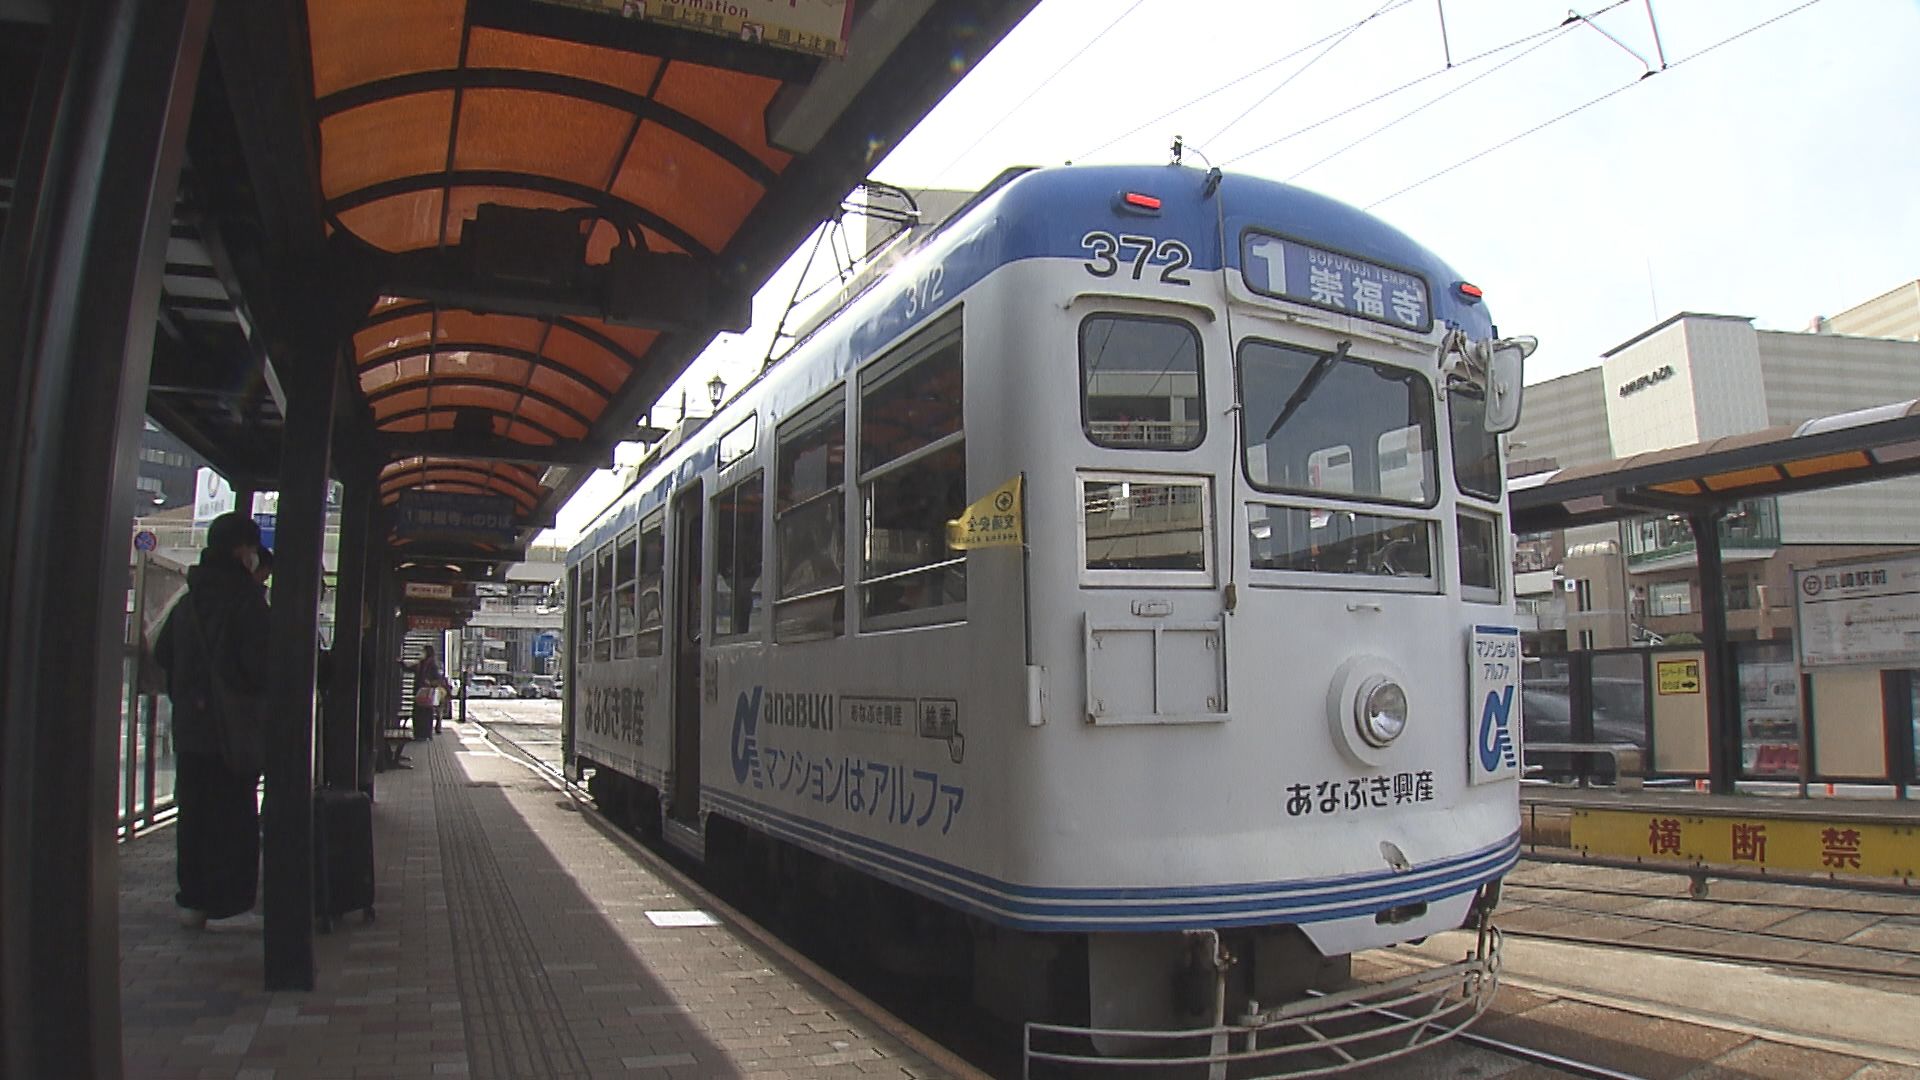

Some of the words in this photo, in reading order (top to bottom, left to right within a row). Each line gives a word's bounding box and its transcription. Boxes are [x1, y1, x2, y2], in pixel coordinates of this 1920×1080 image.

[1082, 231, 1193, 287] 372
[1252, 241, 1287, 294] 1
[905, 263, 944, 319] 372
[1310, 265, 1421, 326] 崇福寺
[763, 747, 964, 835] マンションはアルファ
[1286, 770, 1434, 816] あなぶき興産
[1649, 818, 1861, 870] 横断禁
